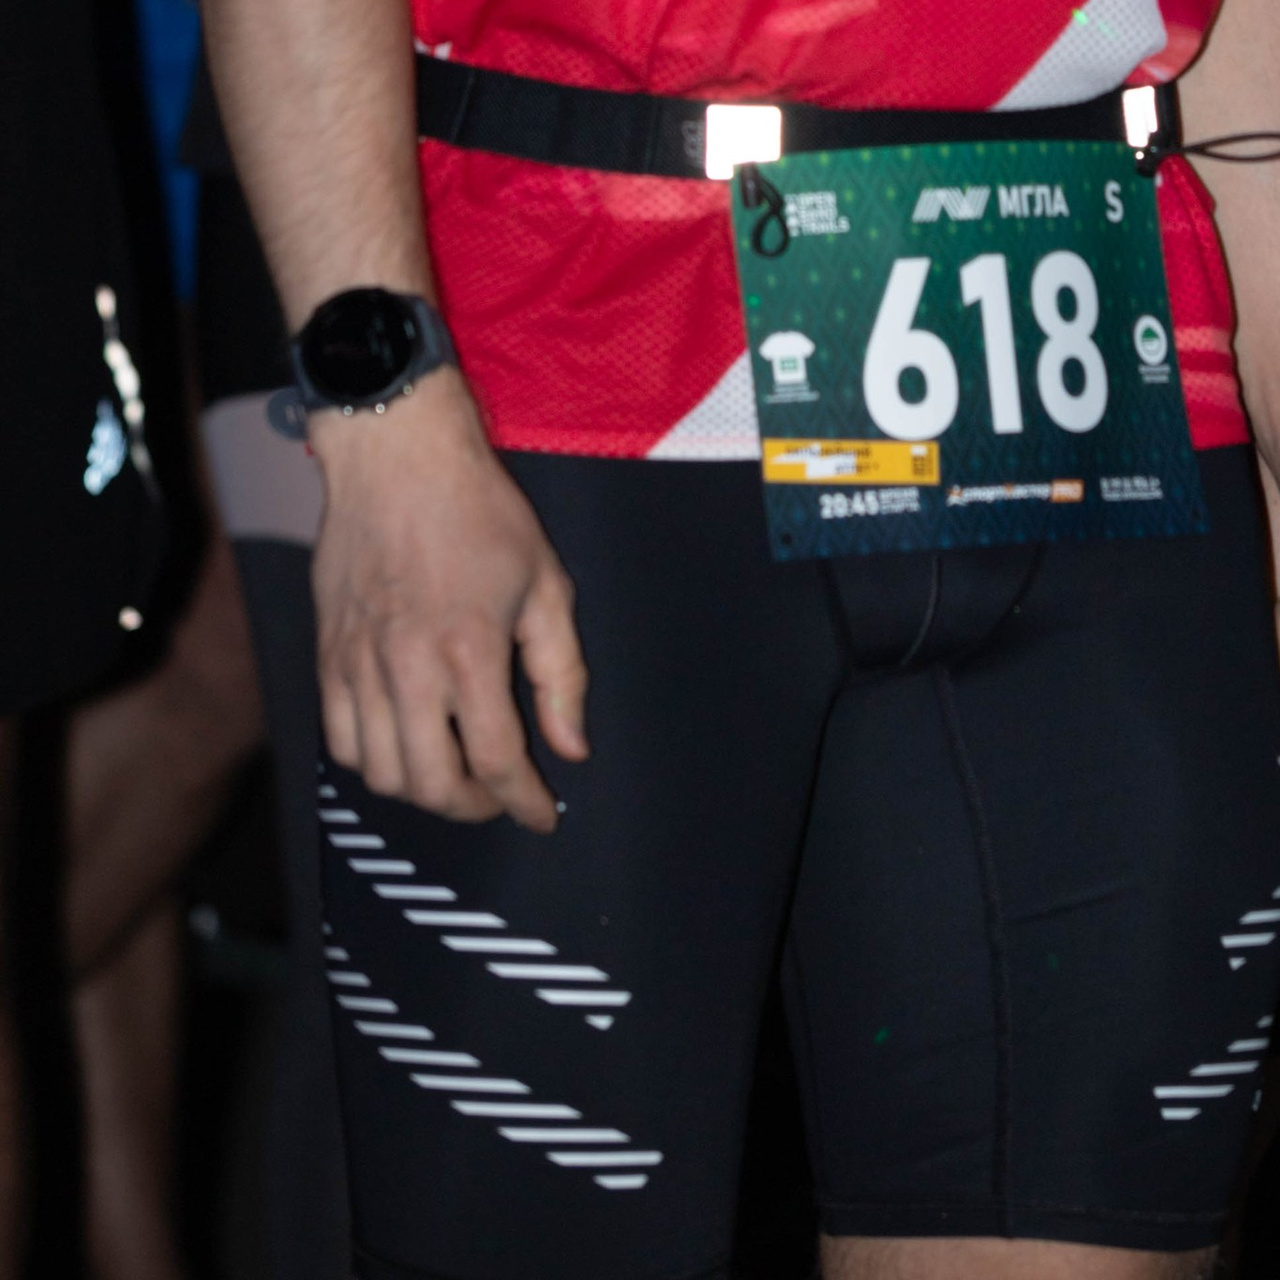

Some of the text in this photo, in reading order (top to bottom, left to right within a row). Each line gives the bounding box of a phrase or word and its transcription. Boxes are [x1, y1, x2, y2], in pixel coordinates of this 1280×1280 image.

[997, 183, 1069, 219] МГЛА
[1105, 180, 1124, 223] S
[862, 249, 1109, 441] 618
[818, 490, 880, 520] 20:45
